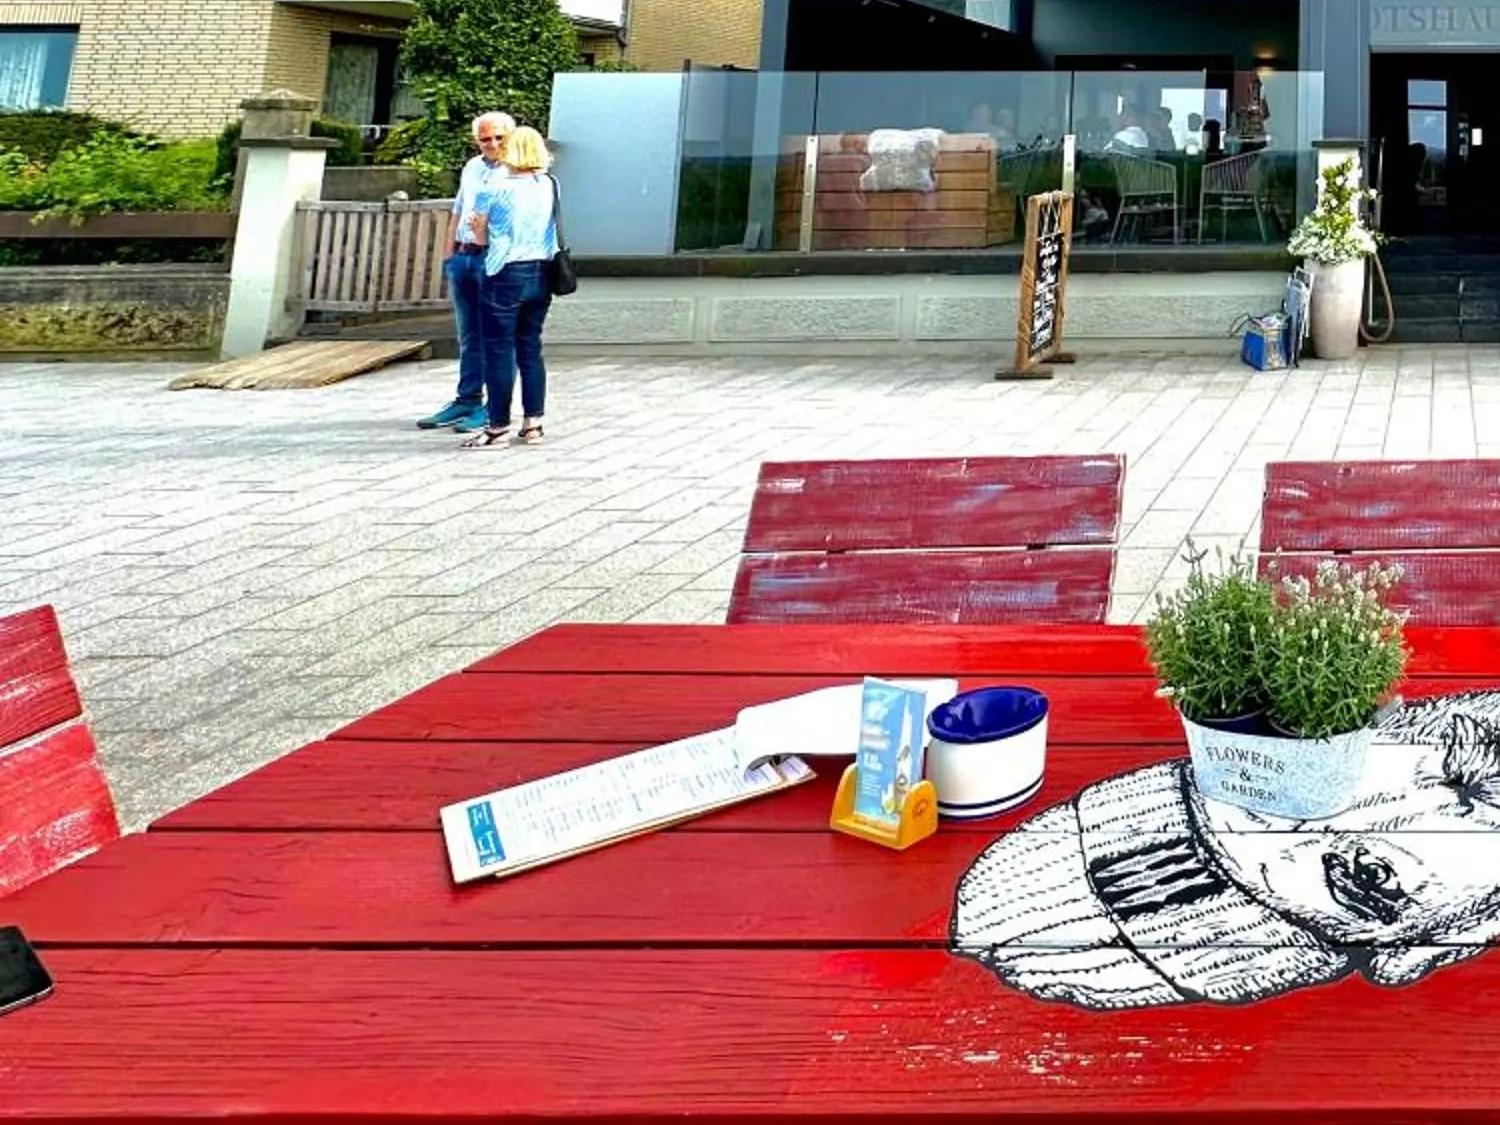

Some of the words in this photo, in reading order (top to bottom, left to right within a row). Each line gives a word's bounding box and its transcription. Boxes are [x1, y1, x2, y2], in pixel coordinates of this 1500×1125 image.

[1206, 746, 1286, 776] FLOWERS
[1239, 767, 1251, 782] &
[1221, 780, 1278, 802] GARDEN
